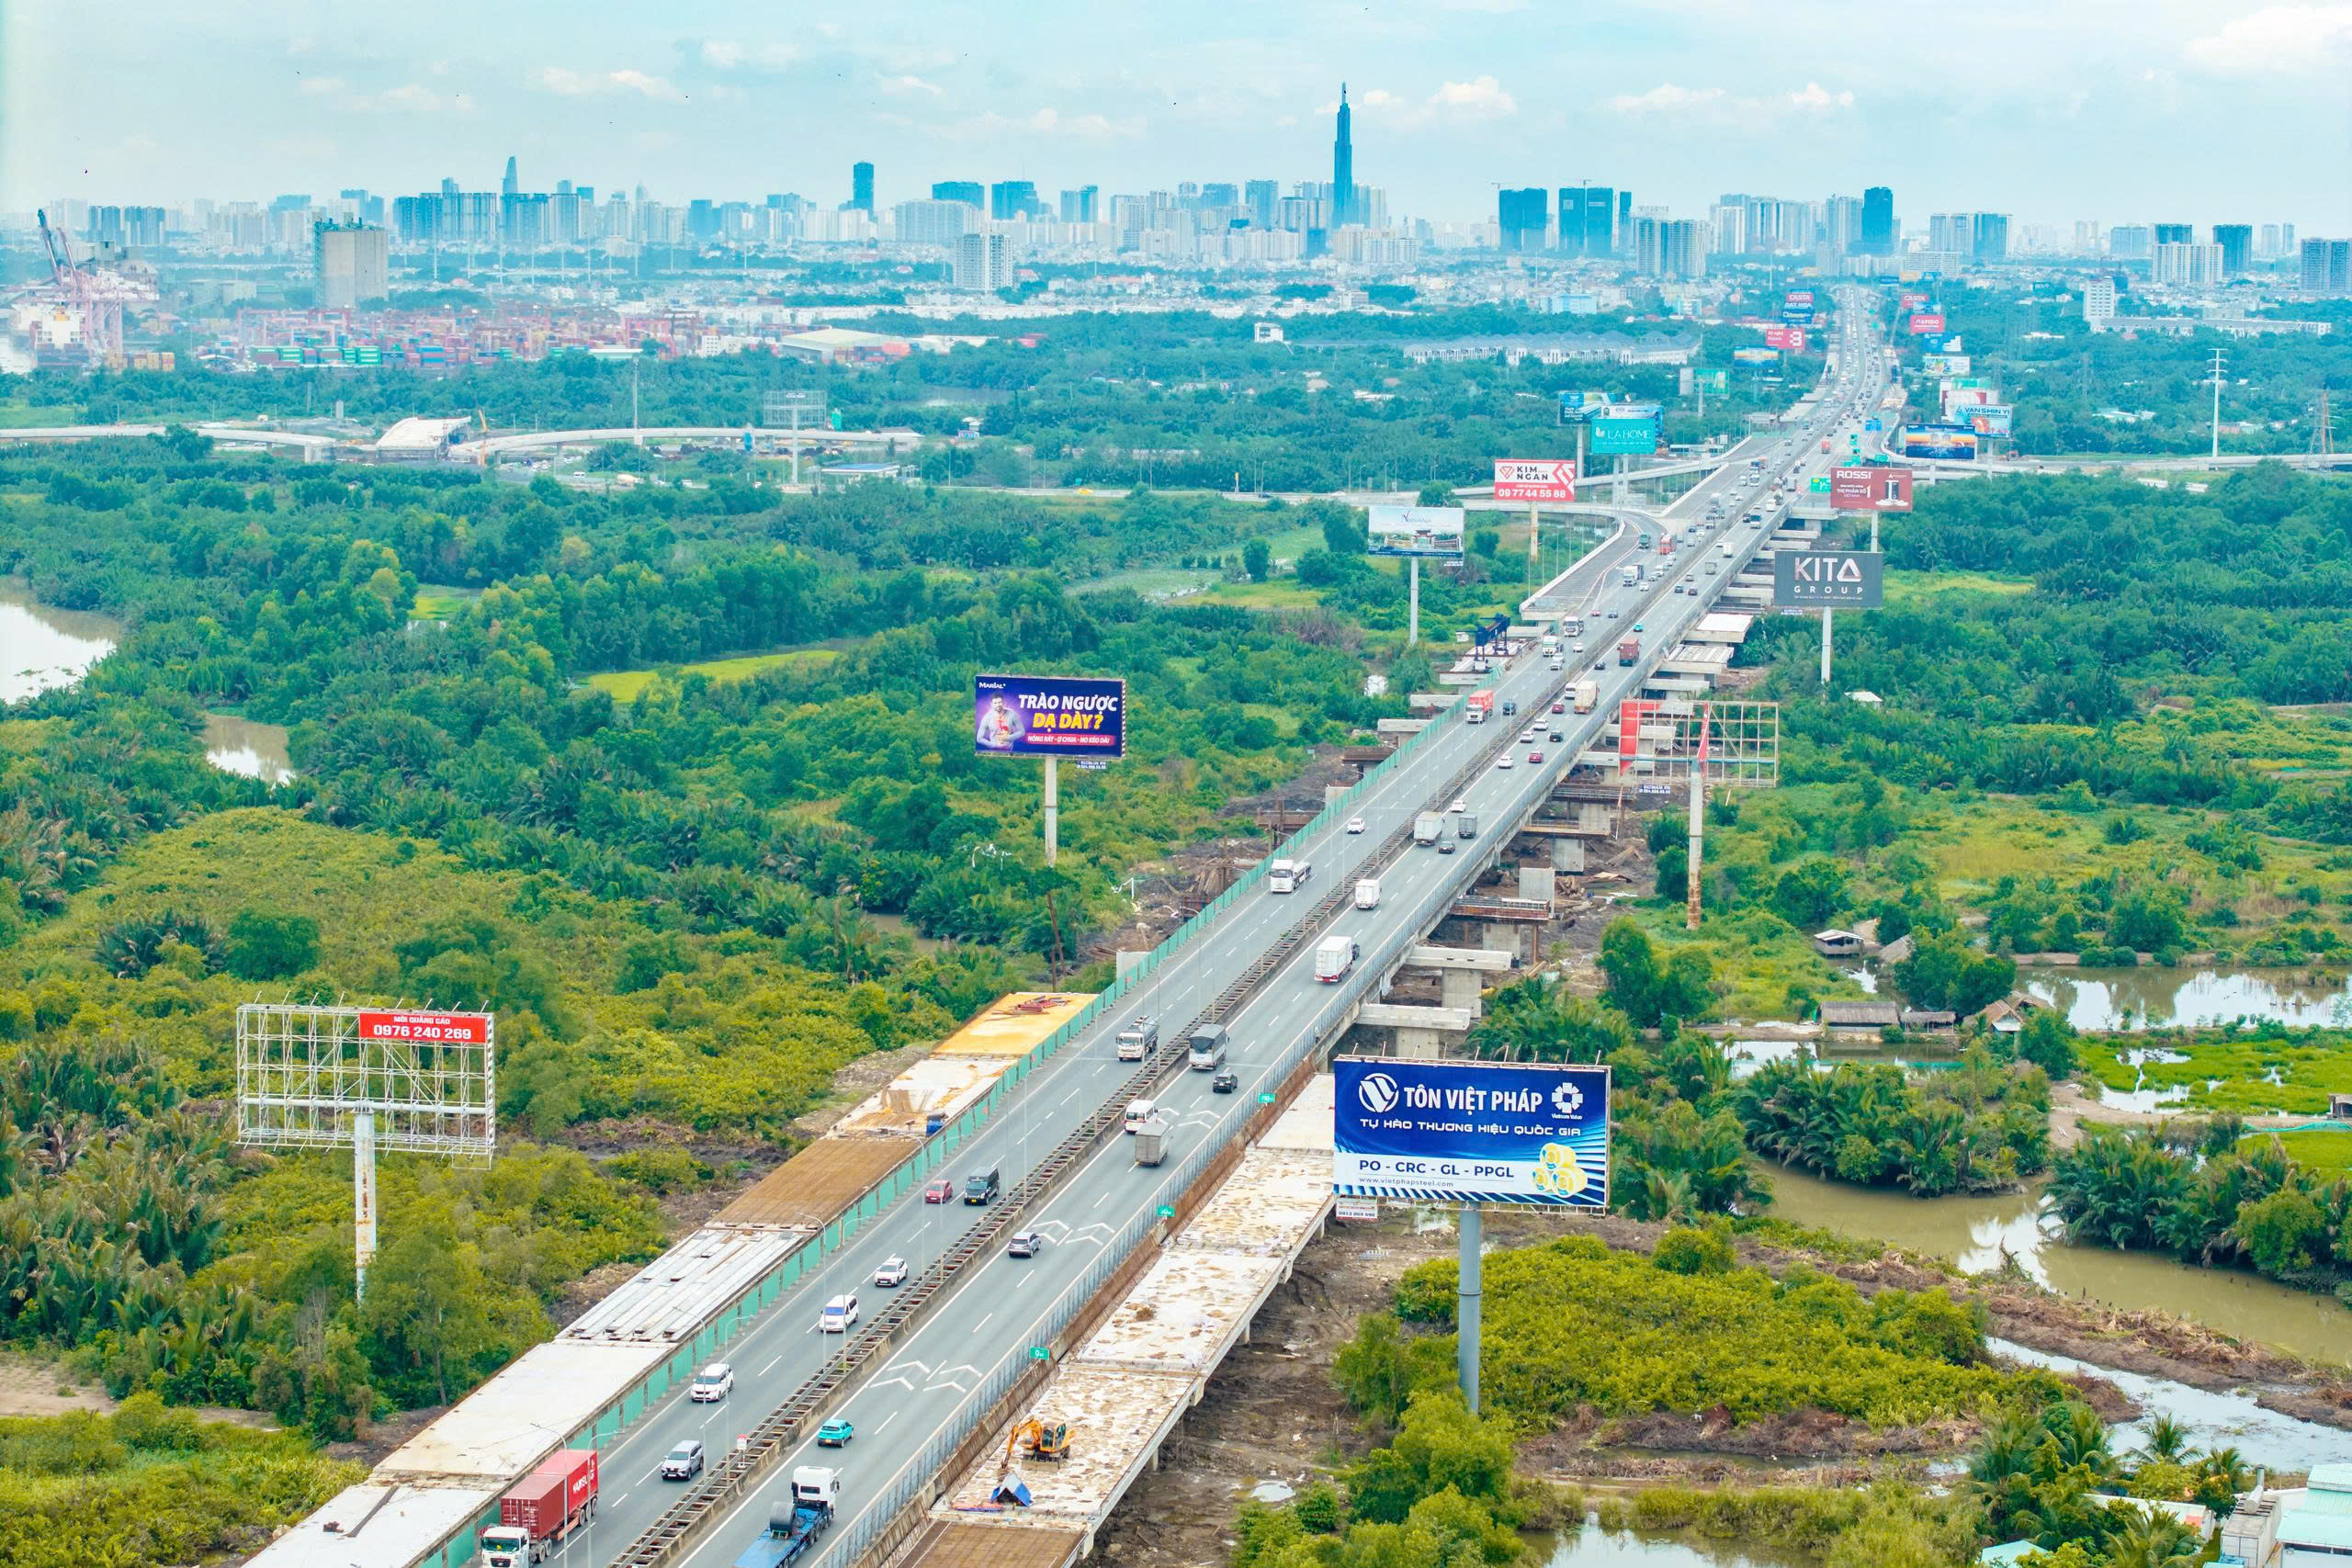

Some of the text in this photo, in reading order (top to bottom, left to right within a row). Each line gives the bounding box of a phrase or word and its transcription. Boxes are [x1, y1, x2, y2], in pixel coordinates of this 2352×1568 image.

[1837, 470, 1873, 479] ROSSI
[1794, 557, 1862, 582] KITA
[1793, 585, 1863, 594] GROUP
[1018, 692, 1118, 715] TRÀO NGƯỢC
[1033, 713, 1057, 732] DẠ
[373, 1024, 471, 1040] 0976 240 269
[1403, 1083, 1544, 1116] TÔN VIỆT PHÁP
[1384, 1118, 1413, 1130] HÀO
[1477, 1122, 1510, 1135] HIỆU
[1558, 1127, 1581, 1136] GIA
[1359, 1159, 1381, 1171] PO
[1395, 1161, 1427, 1174] CRC
[1440, 1164, 1460, 1176] GL
[1474, 1166, 1515, 1179] PPGL
[1359, 1177, 1454, 1188] www.vietphapsteel.com
